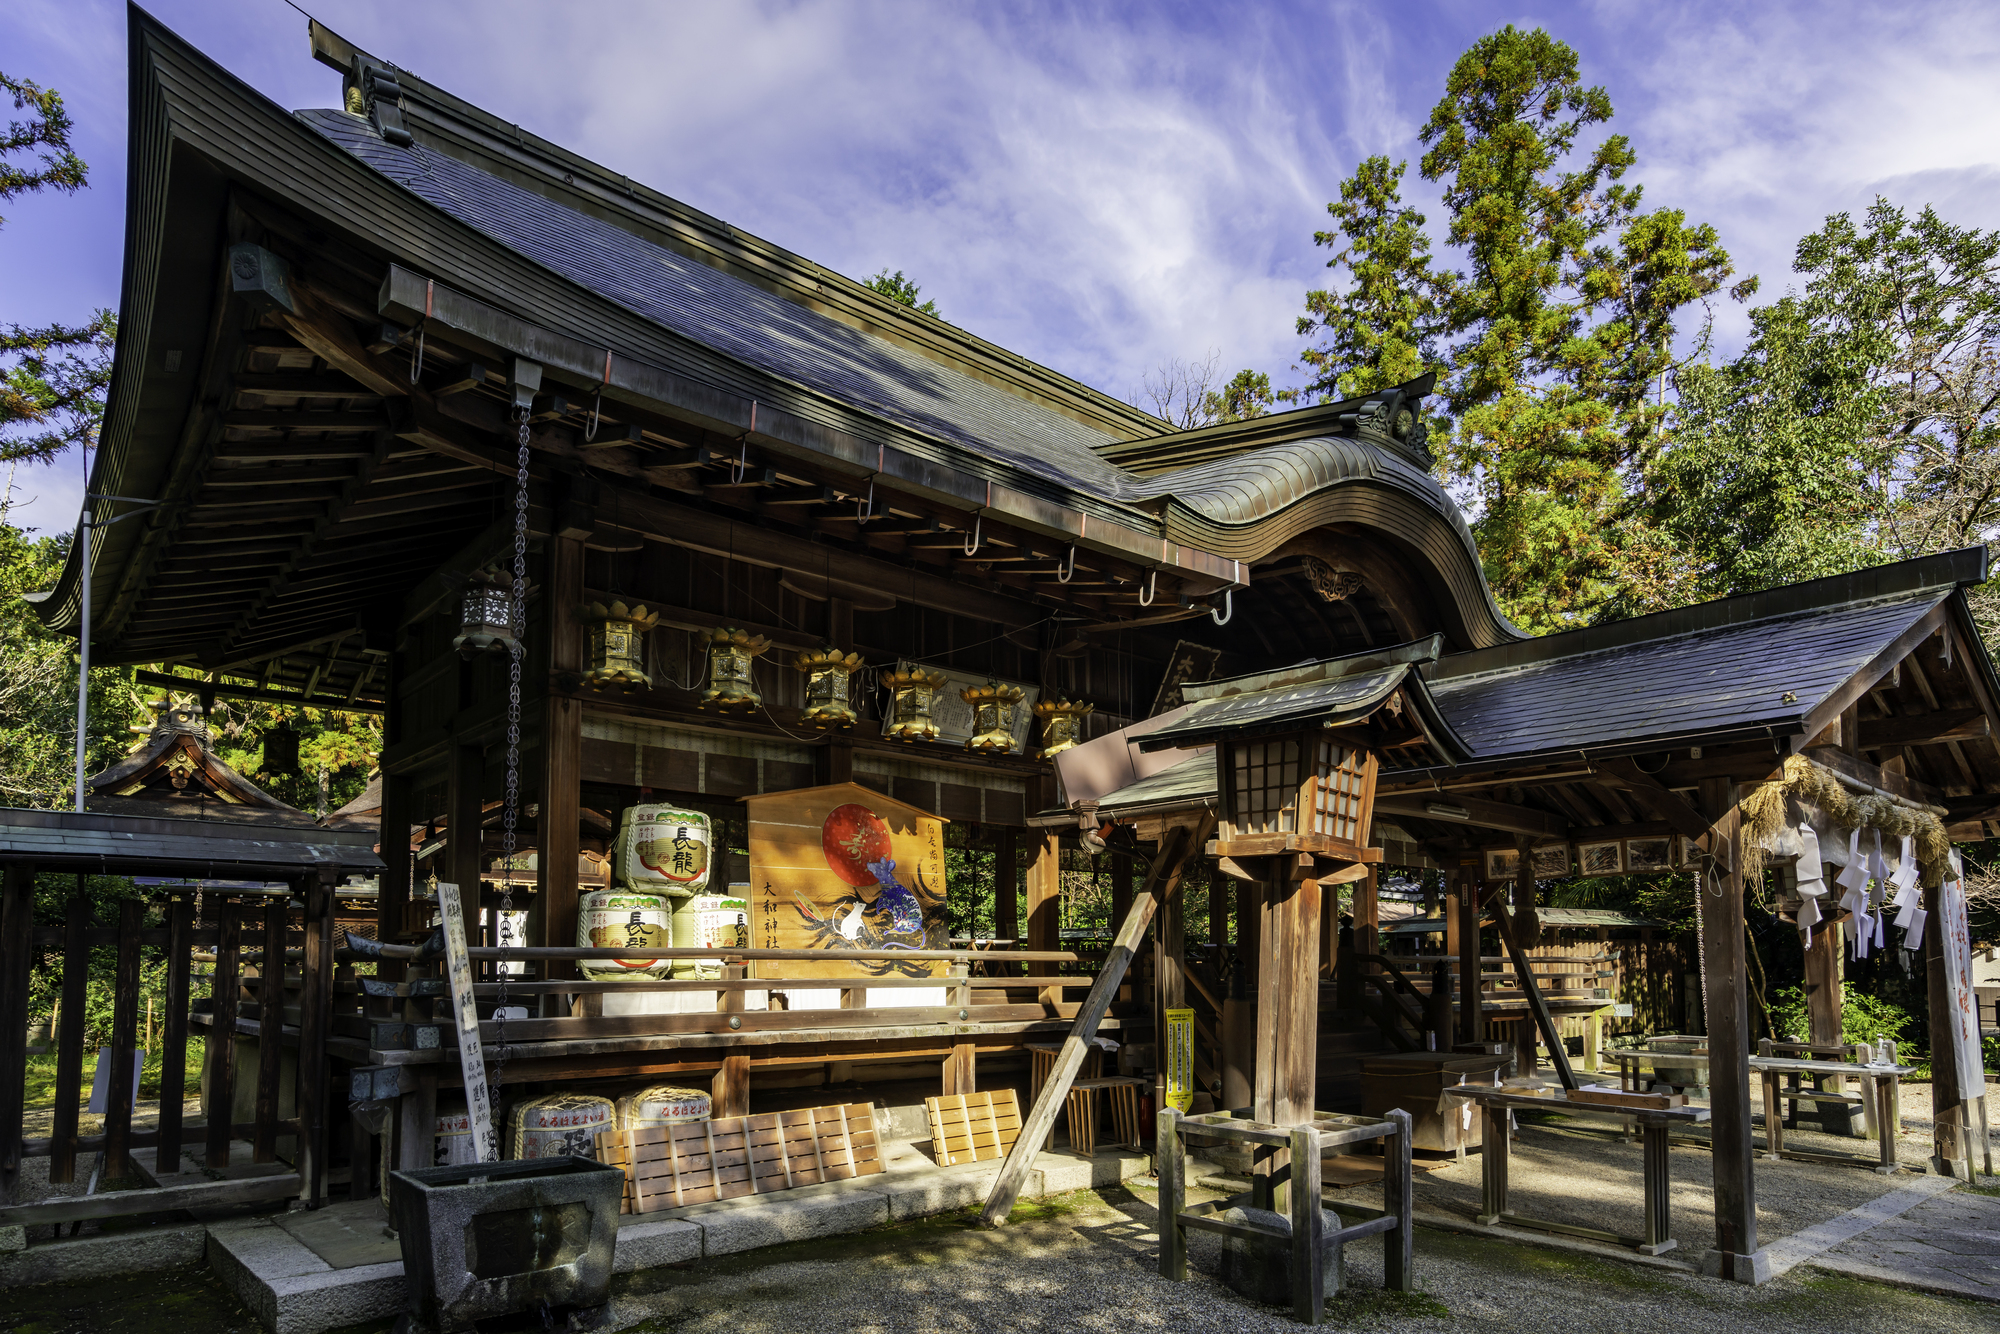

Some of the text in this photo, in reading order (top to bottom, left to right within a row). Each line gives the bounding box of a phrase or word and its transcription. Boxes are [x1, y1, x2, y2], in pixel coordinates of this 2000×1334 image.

[672, 827, 698, 874] 長龍
[763, 881, 780, 949] 大和神社
